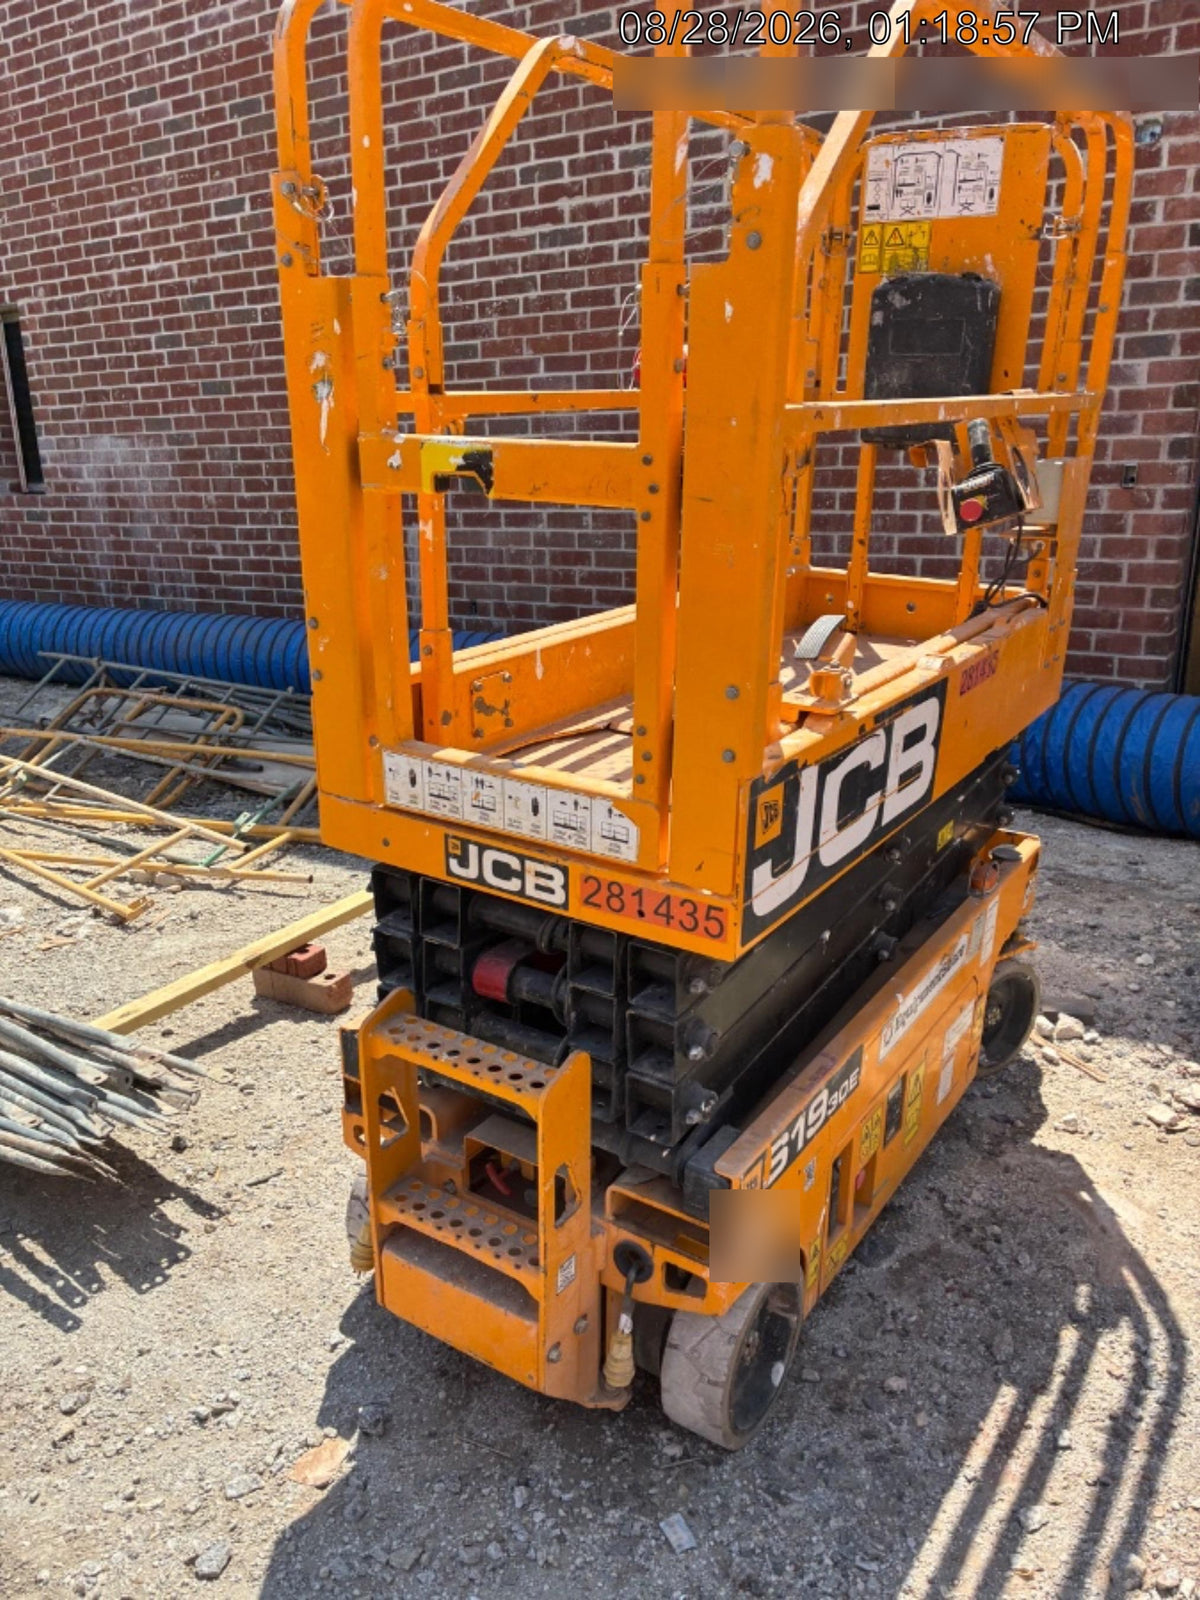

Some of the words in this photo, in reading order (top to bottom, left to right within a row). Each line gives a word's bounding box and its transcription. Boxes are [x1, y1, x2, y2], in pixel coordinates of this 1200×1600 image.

[752, 696, 941, 917] JCB
[448, 843, 567, 906] JCB
[583, 875, 725, 939] 281435
